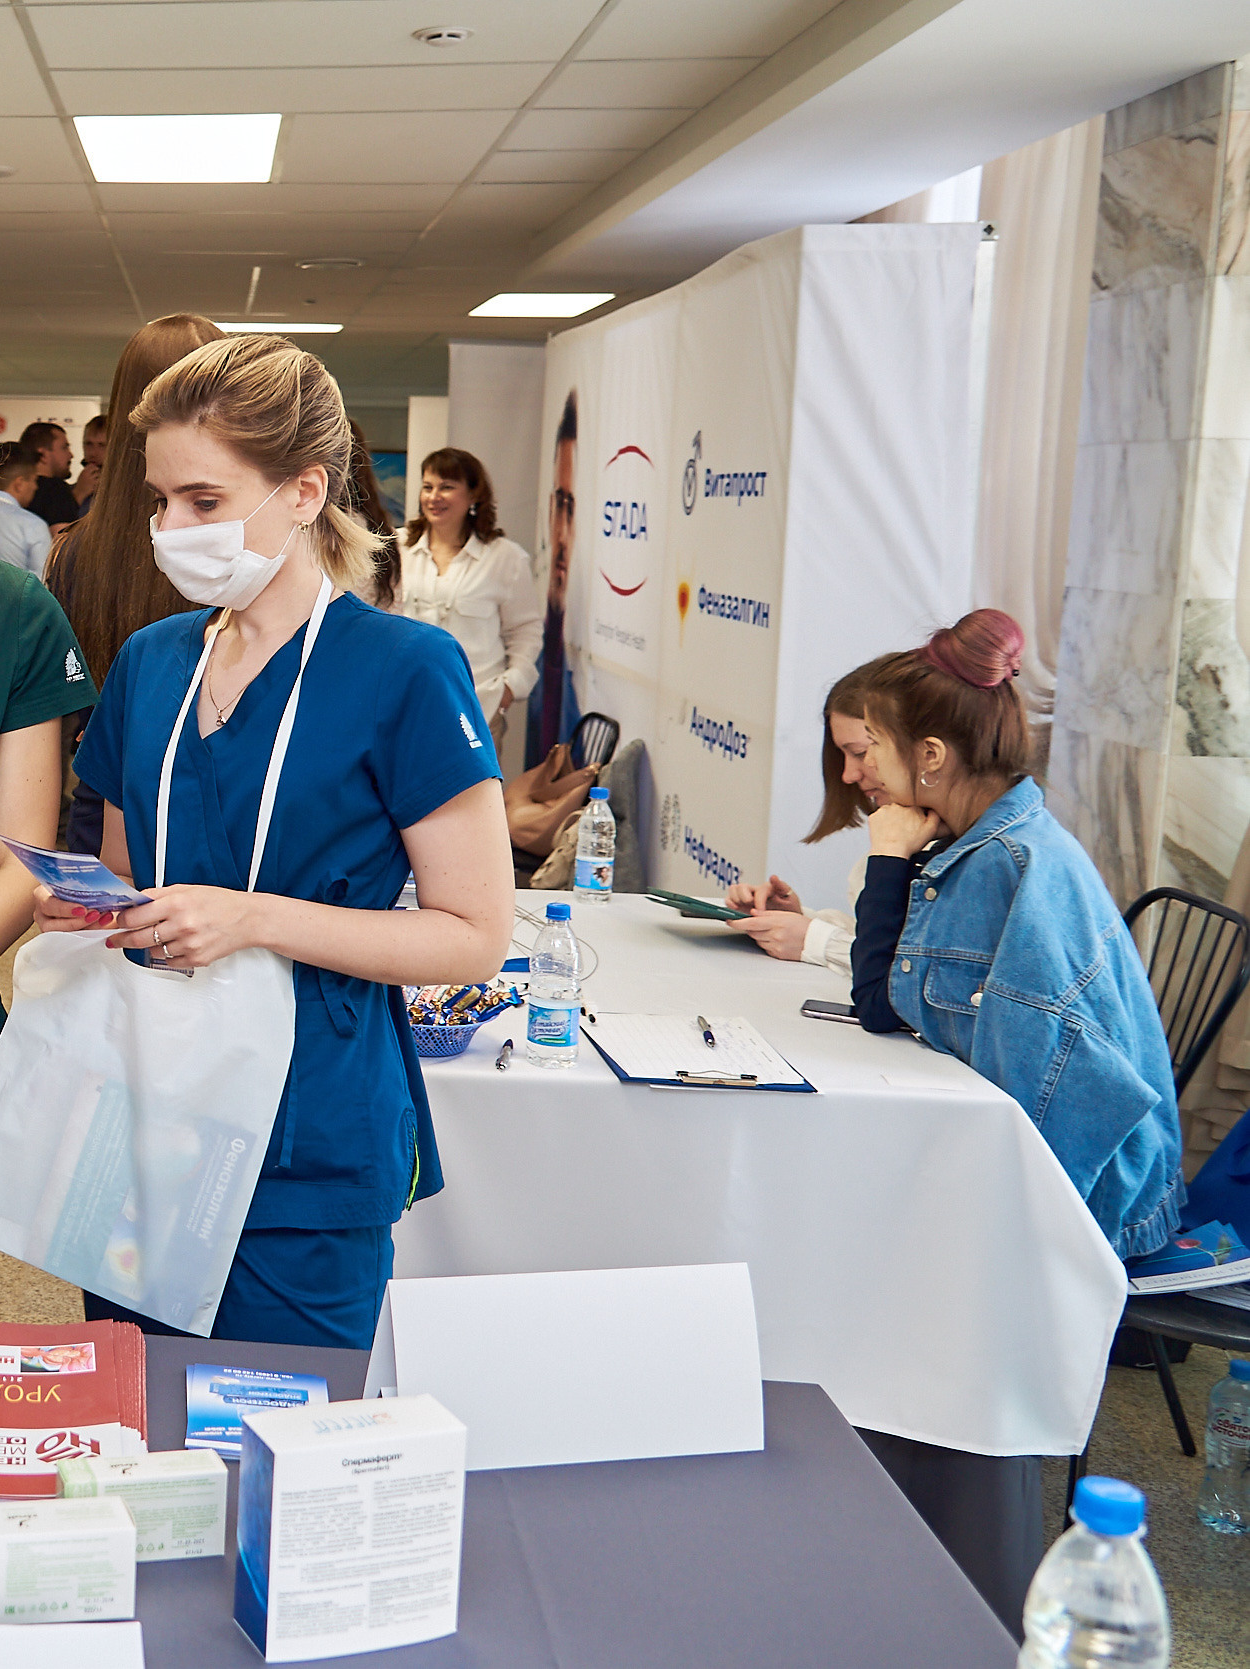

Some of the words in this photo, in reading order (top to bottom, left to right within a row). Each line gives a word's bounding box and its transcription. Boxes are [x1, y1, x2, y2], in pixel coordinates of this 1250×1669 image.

[704, 468, 767, 507] Витапрост
[603, 501, 648, 540] STADA
[698, 584, 770, 628] Феназалгин
[690, 706, 747, 761] АндроДоз
[198, 1138, 246, 1239] Феназалгин
[1217, 1419, 1250, 1433] СВЯТО
